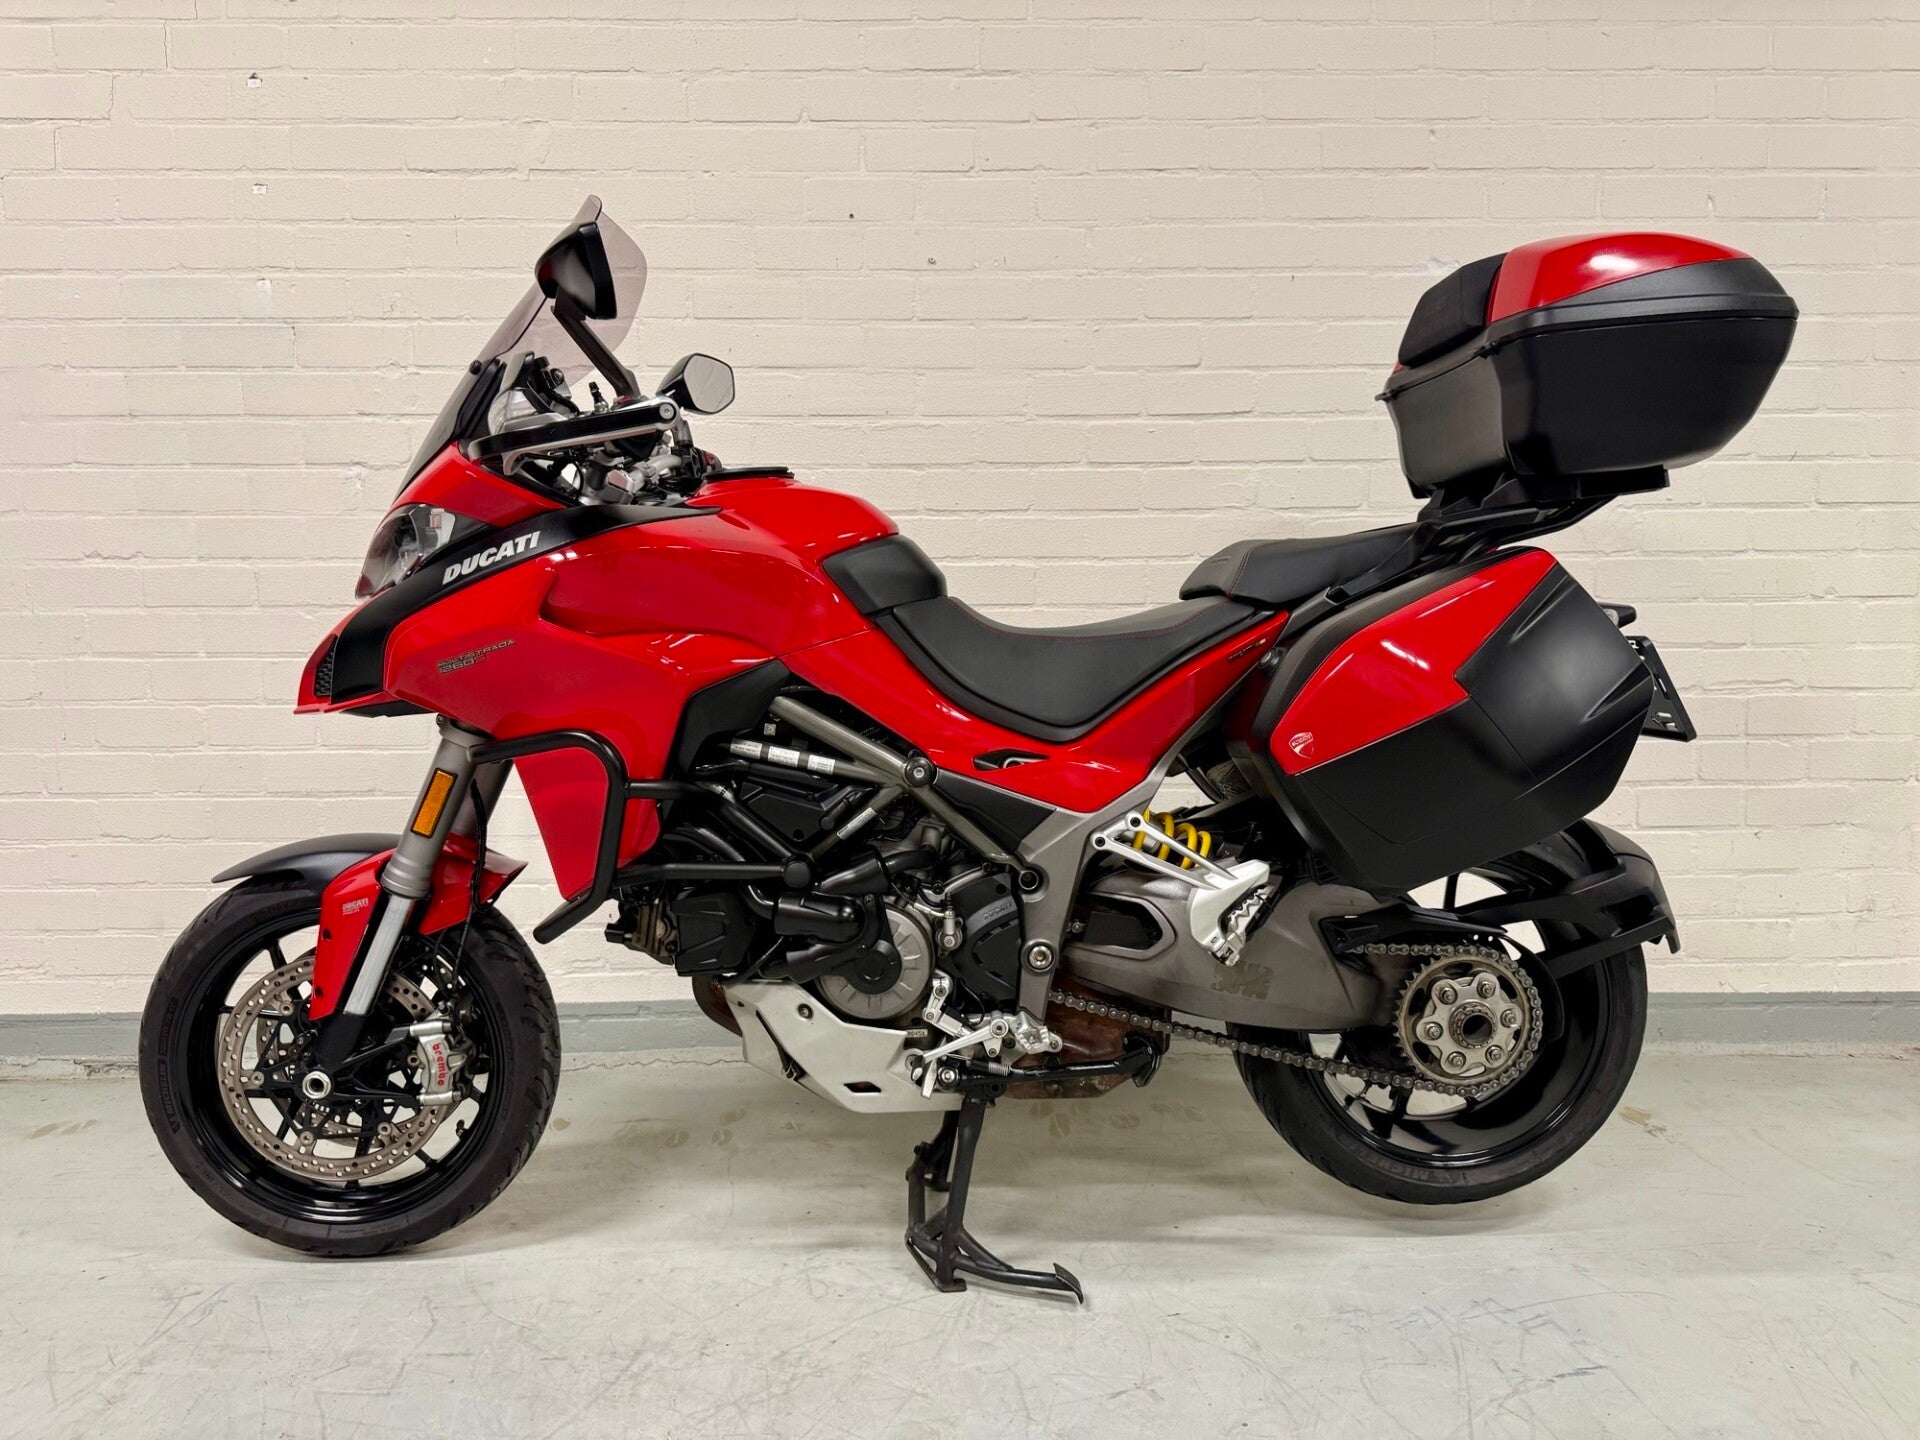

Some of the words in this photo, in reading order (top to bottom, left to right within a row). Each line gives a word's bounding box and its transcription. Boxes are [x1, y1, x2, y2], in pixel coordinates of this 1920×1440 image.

[442, 530, 541, 585] DUCATI
[437, 639, 515, 668] MULTISTRADA
[342, 897, 369, 911] DUCATI
[432, 1042, 447, 1086] brembo
